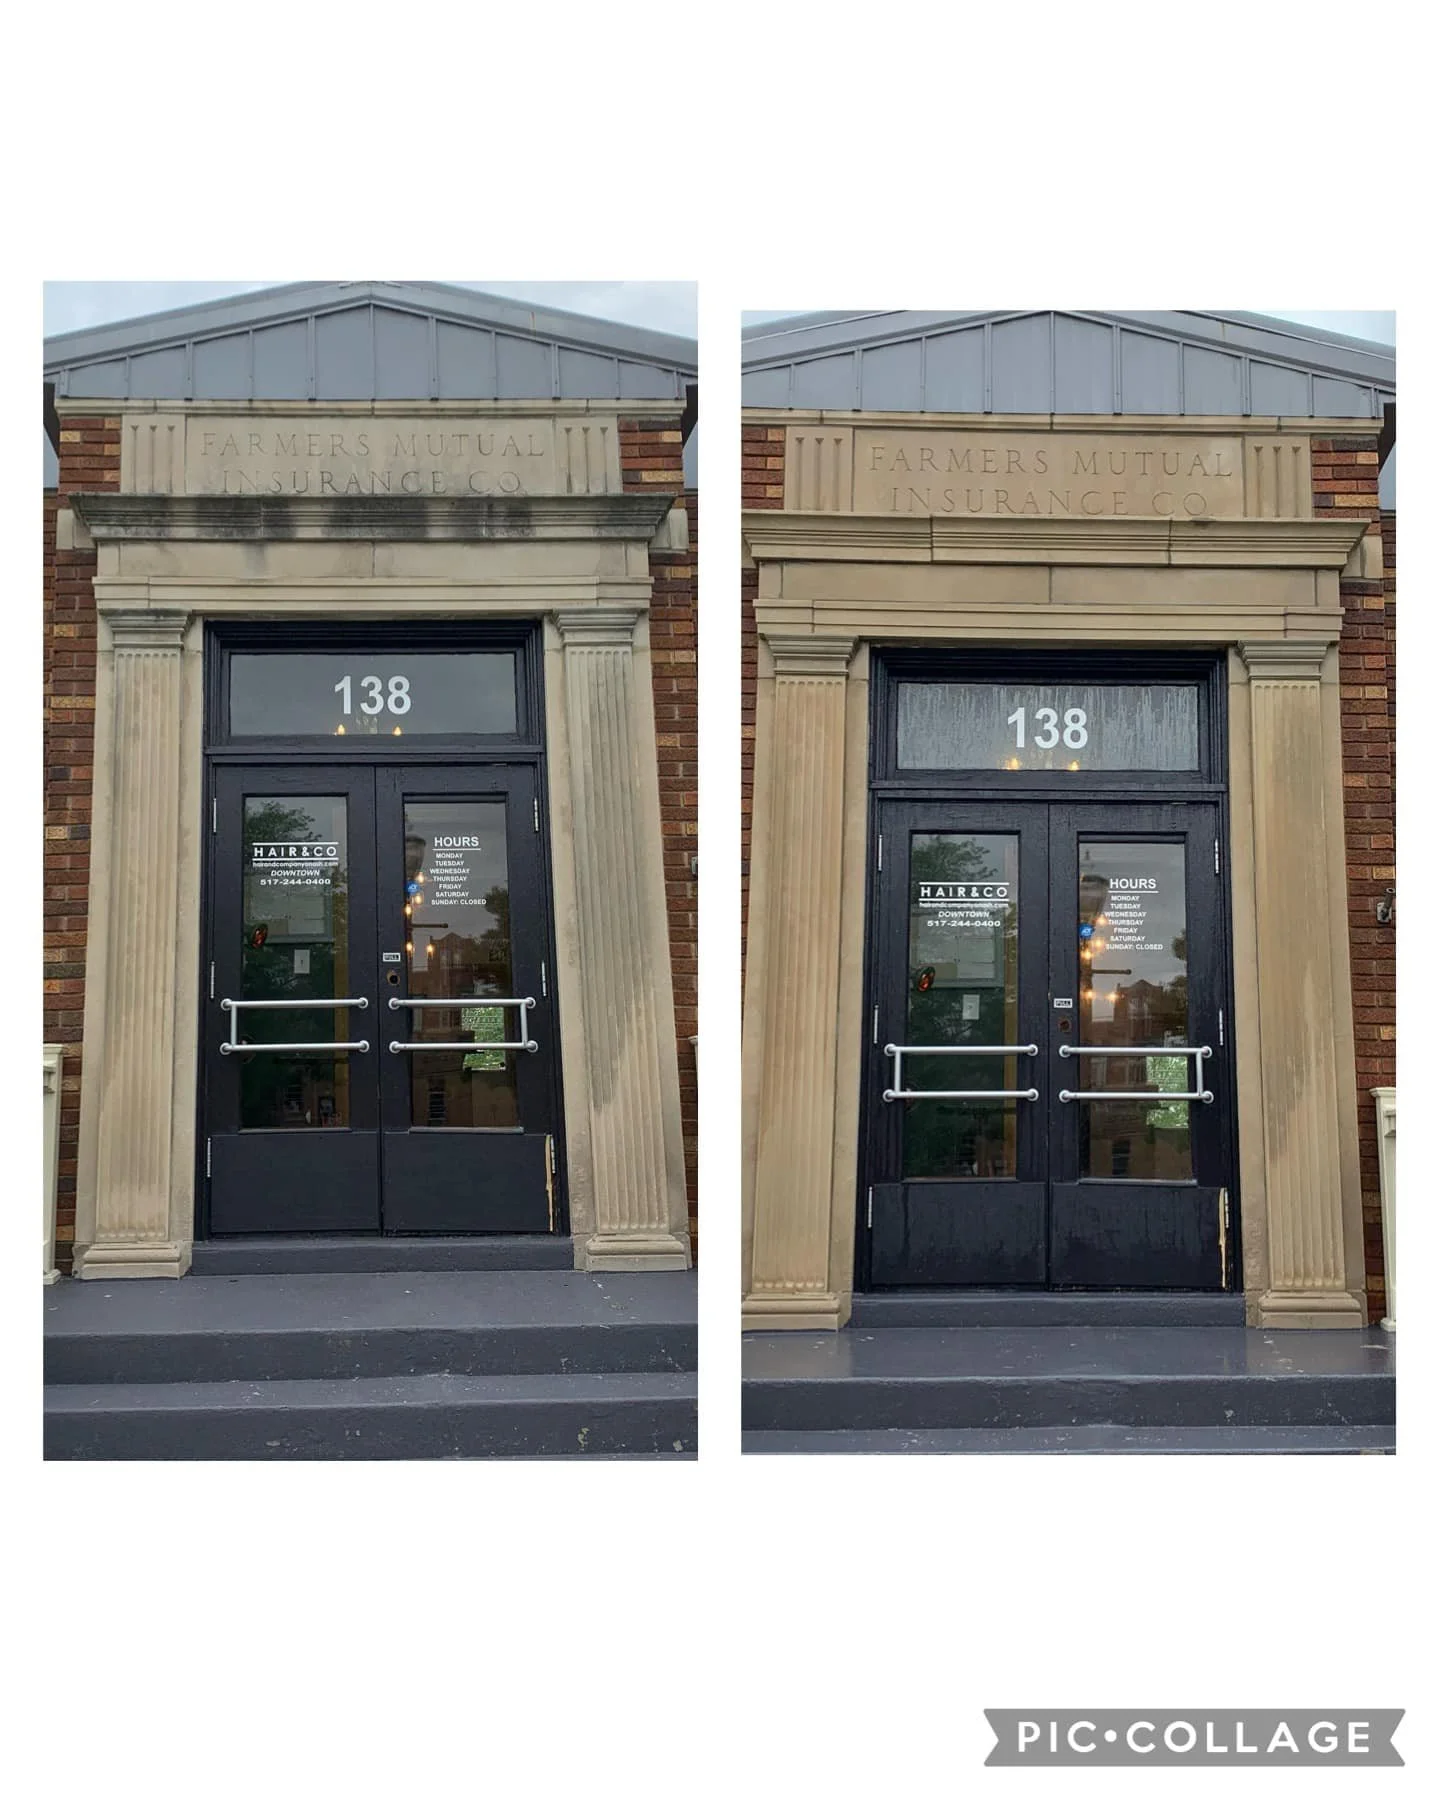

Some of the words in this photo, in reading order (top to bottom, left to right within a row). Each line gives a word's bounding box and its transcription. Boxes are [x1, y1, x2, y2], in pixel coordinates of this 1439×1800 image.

[200, 432, 370, 456] FARMERS
[394, 432, 545, 457] MUTUAL
[870, 446, 1048, 474] FARMERS
[1072, 450, 1233, 477] MUTUAL
[221, 469, 447, 494] INSURANCE
[889, 487, 1129, 515] INSURANCE
[335, 675, 411, 715] 138
[1007, 707, 1088, 749] 138
[434, 836, 479, 847] HOURS
[254, 846, 337, 857] HAIR&CO
[260, 878, 332, 886] 517-244-0400
[270, 869, 320, 877] DOWNTOWN
[920, 886, 1008, 897] HAIR&CO
[1109, 878, 1157, 889] HOURS
